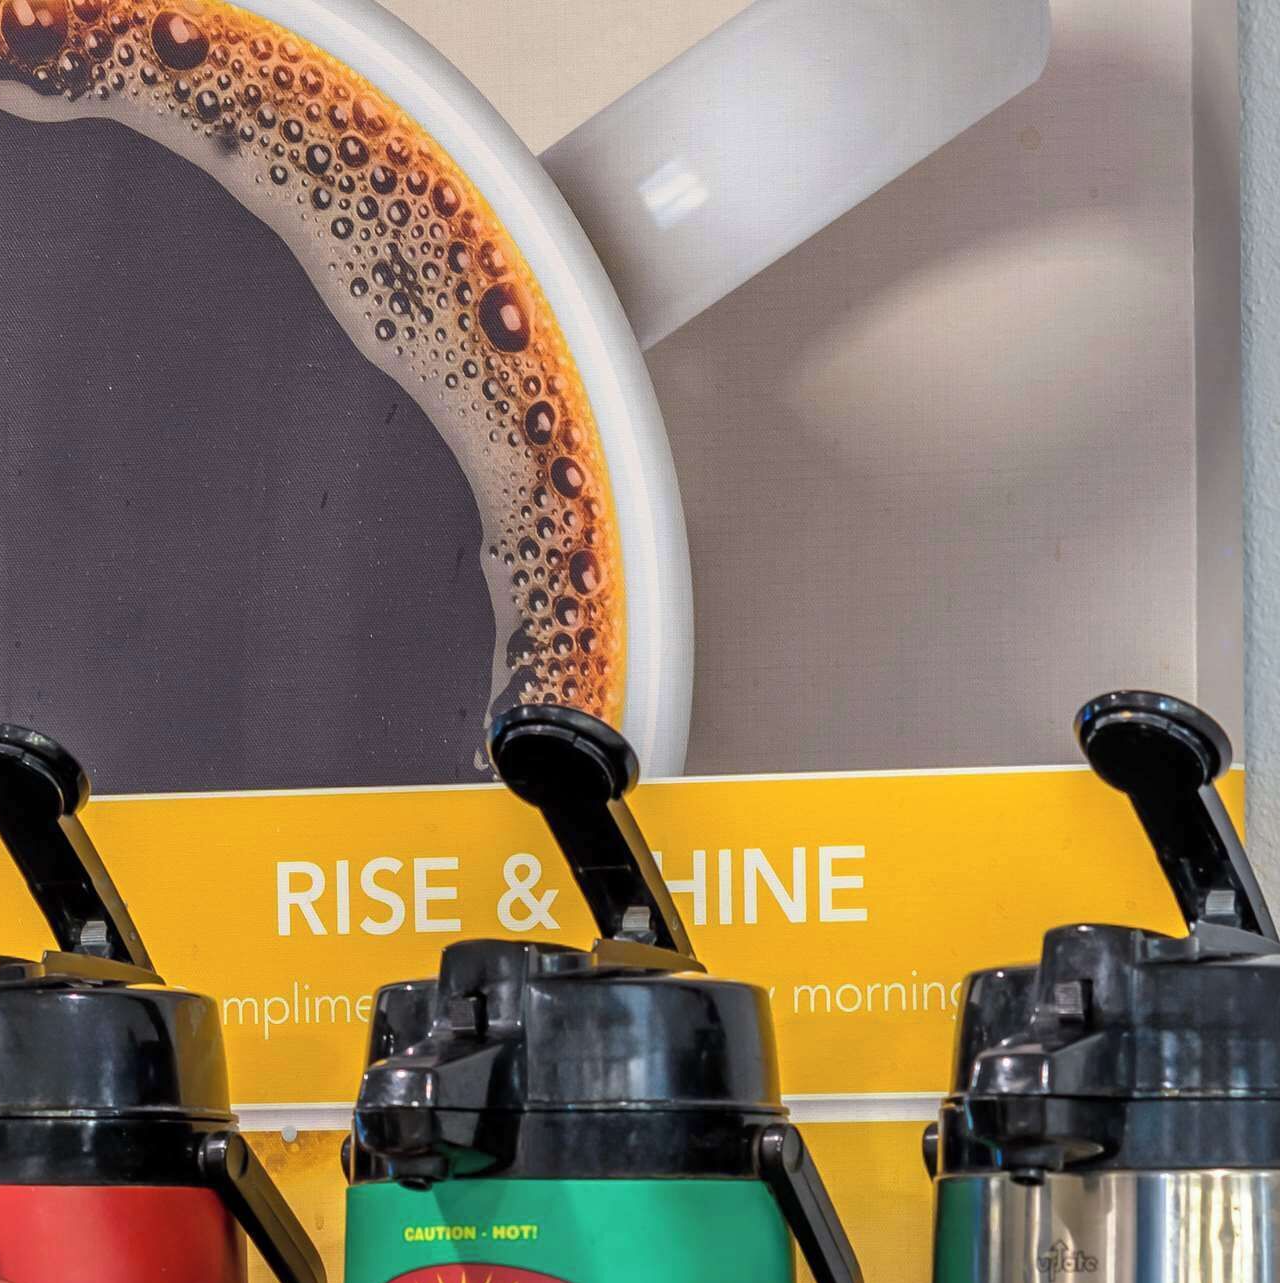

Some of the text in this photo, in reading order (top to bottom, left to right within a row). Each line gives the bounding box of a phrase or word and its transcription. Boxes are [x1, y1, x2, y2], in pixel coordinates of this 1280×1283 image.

[276, 845, 868, 937] RISE & HINE
[404, 1226, 477, 1242] CAUTION
[492, 1225, 538, 1241] HOT!
